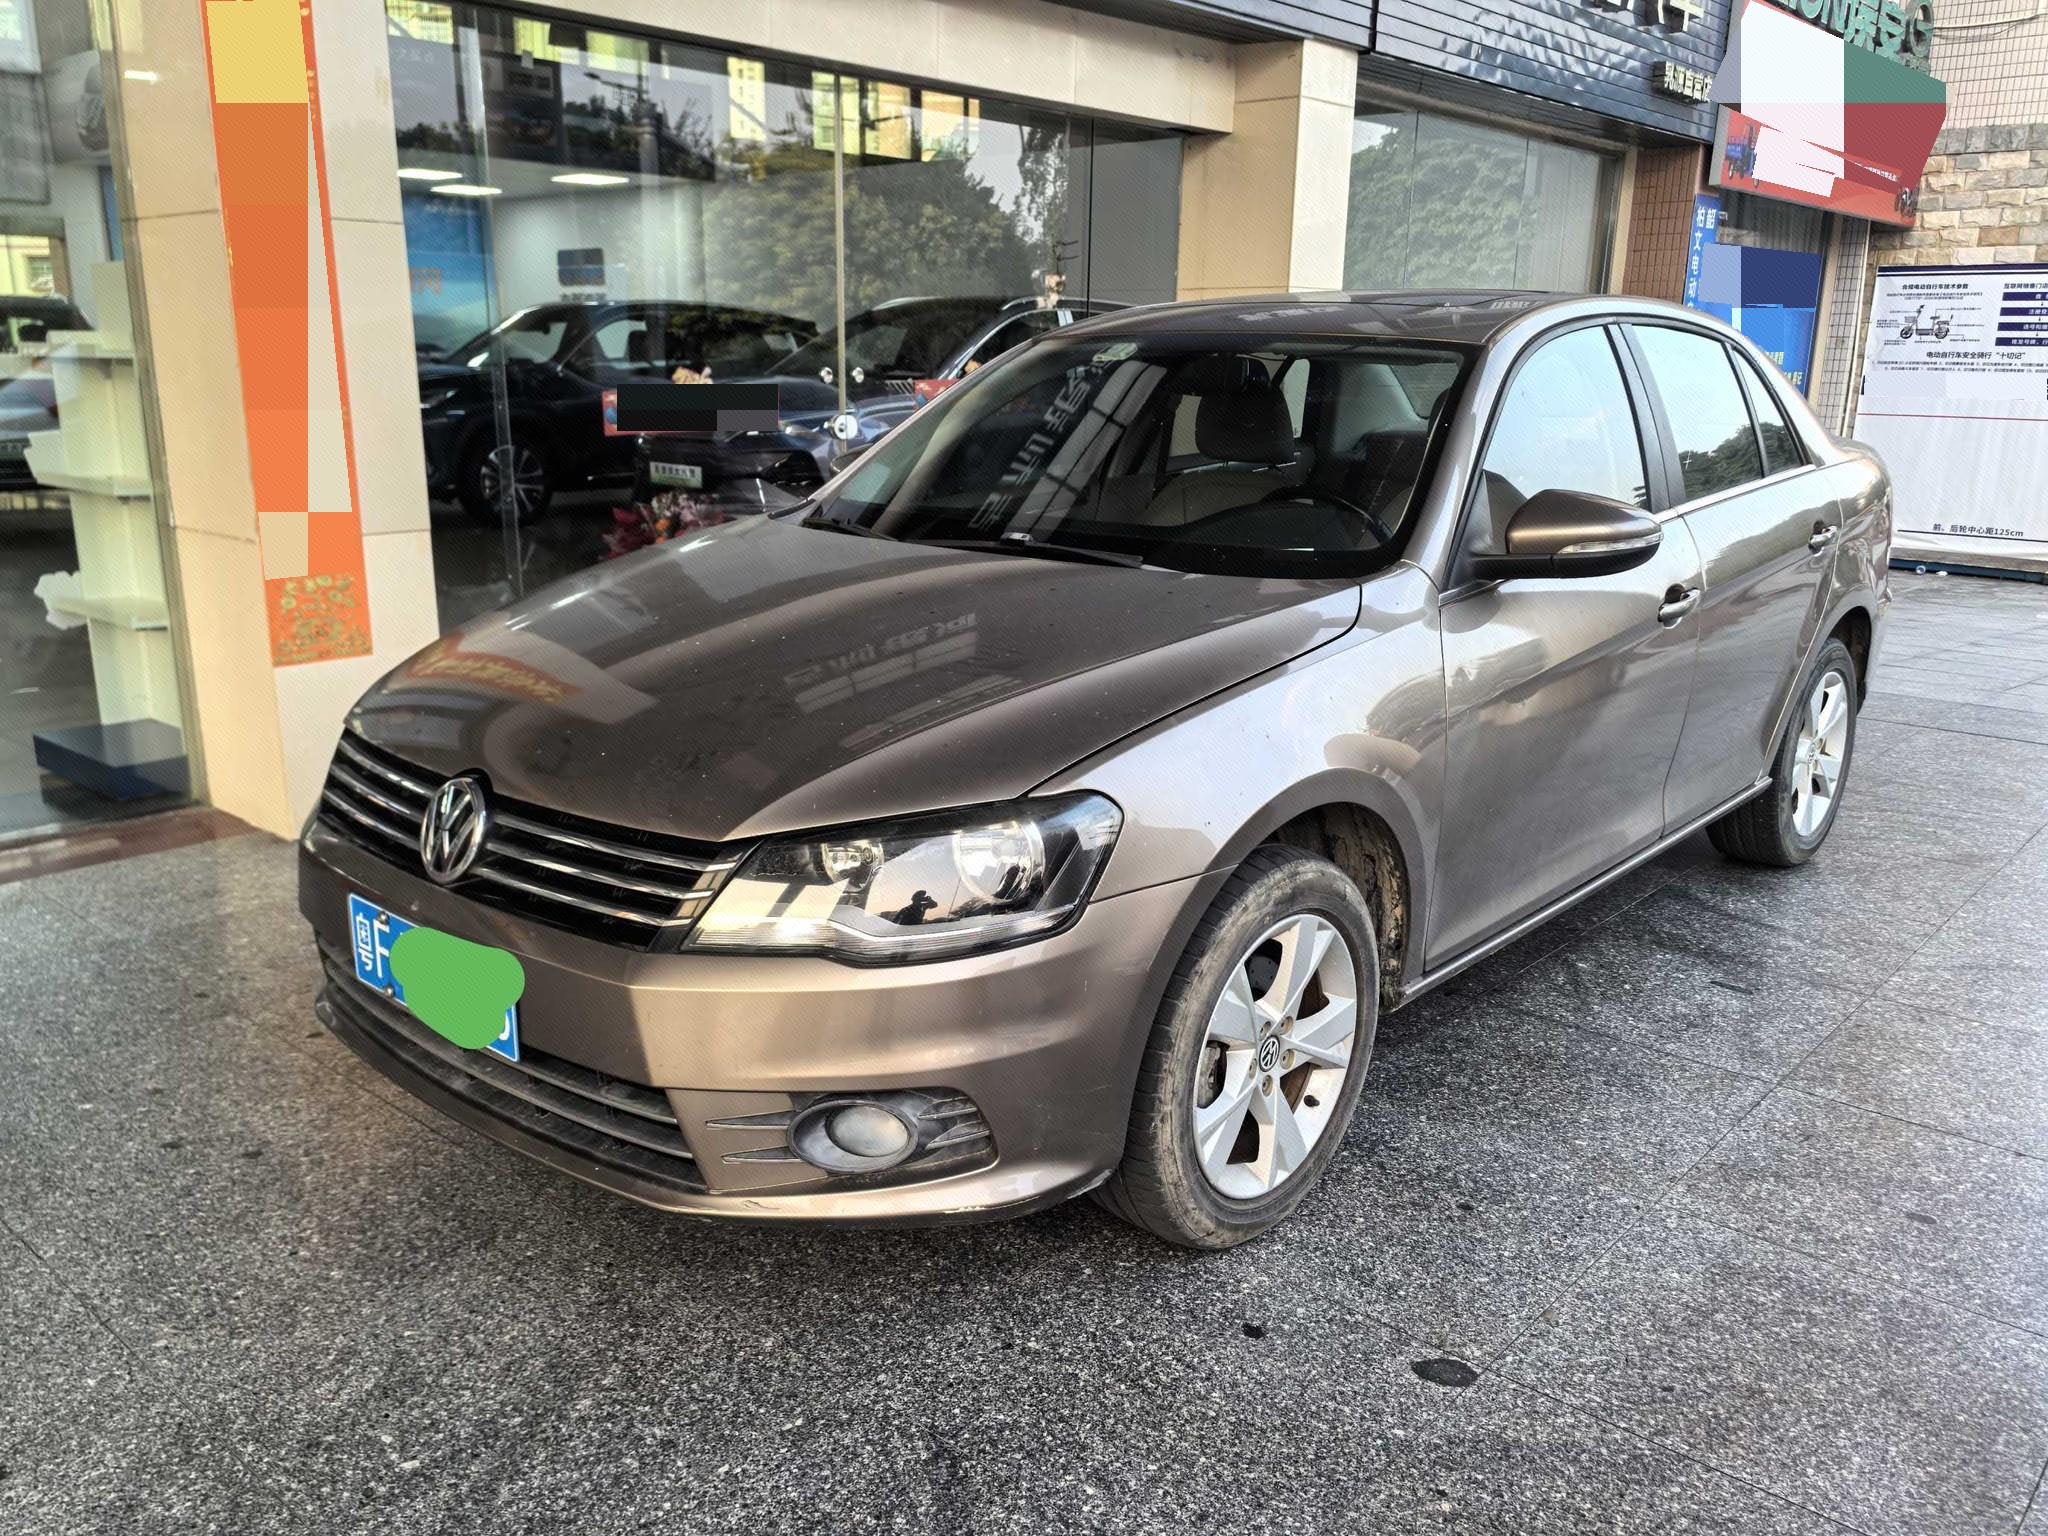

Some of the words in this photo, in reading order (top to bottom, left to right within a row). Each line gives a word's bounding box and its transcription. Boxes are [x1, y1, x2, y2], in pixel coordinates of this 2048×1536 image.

[1933, 523, 2024, 537] 前、后轮中心距125cm
